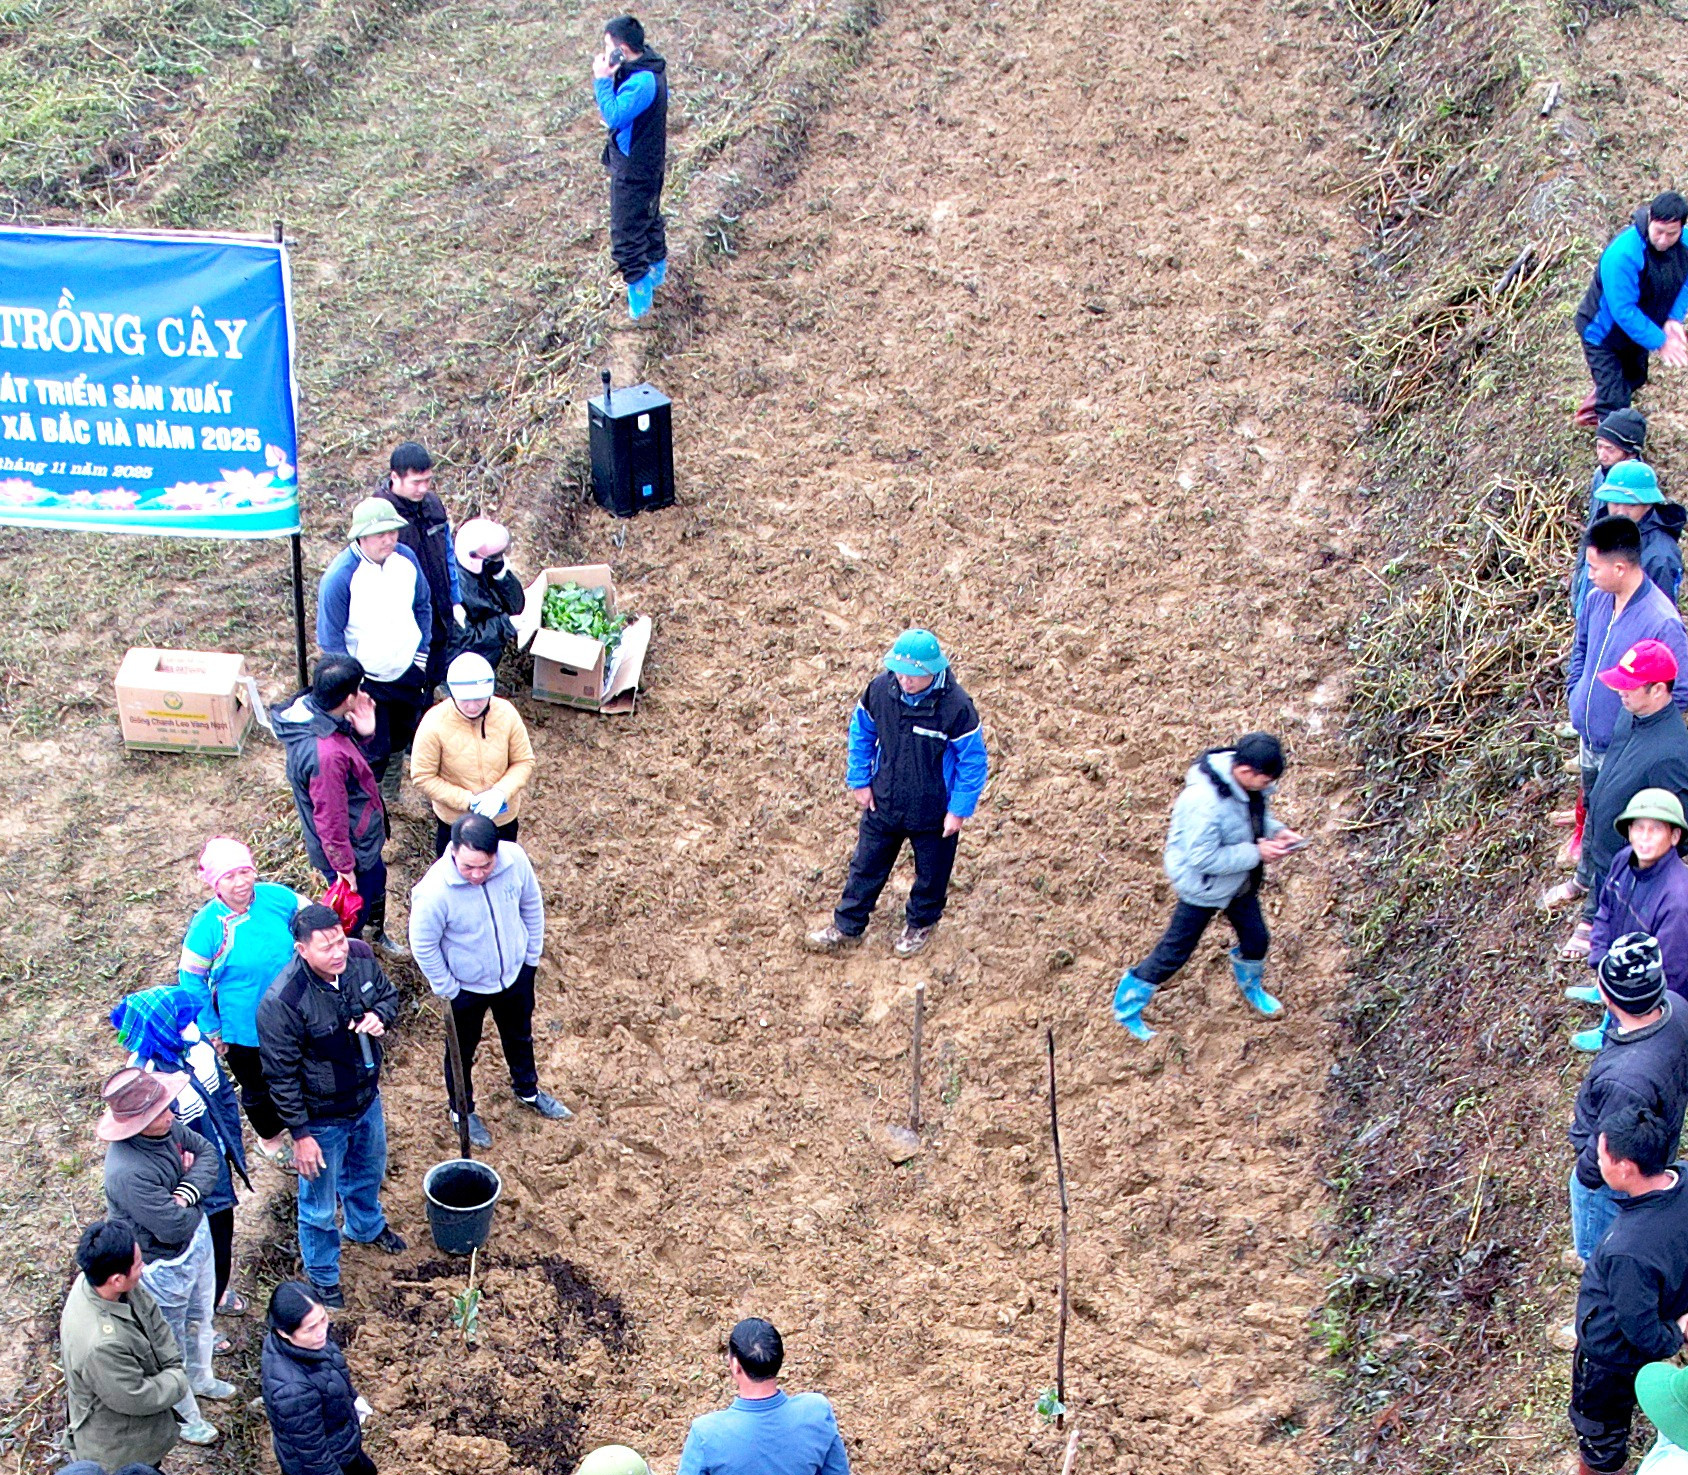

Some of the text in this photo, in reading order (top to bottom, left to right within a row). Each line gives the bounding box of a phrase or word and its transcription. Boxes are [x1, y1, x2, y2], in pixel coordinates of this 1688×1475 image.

[157, 306, 247, 359] CÂY
[33, 372, 106, 407] TRIỂN
[113, 375, 164, 410] SẢN
[169, 380, 232, 413] XUẤT
[1, 412, 36, 441] XÃ
[41, 411, 90, 444] BẮC
[96, 417, 131, 446] HÀ
[136, 420, 194, 449] NĂM
[201, 426, 261, 452] 2025
[50, 462, 66, 474] 11
[70, 462, 108, 476] năm
[112, 465, 153, 478] 2025
[176, 720, 190, 728] Leo
